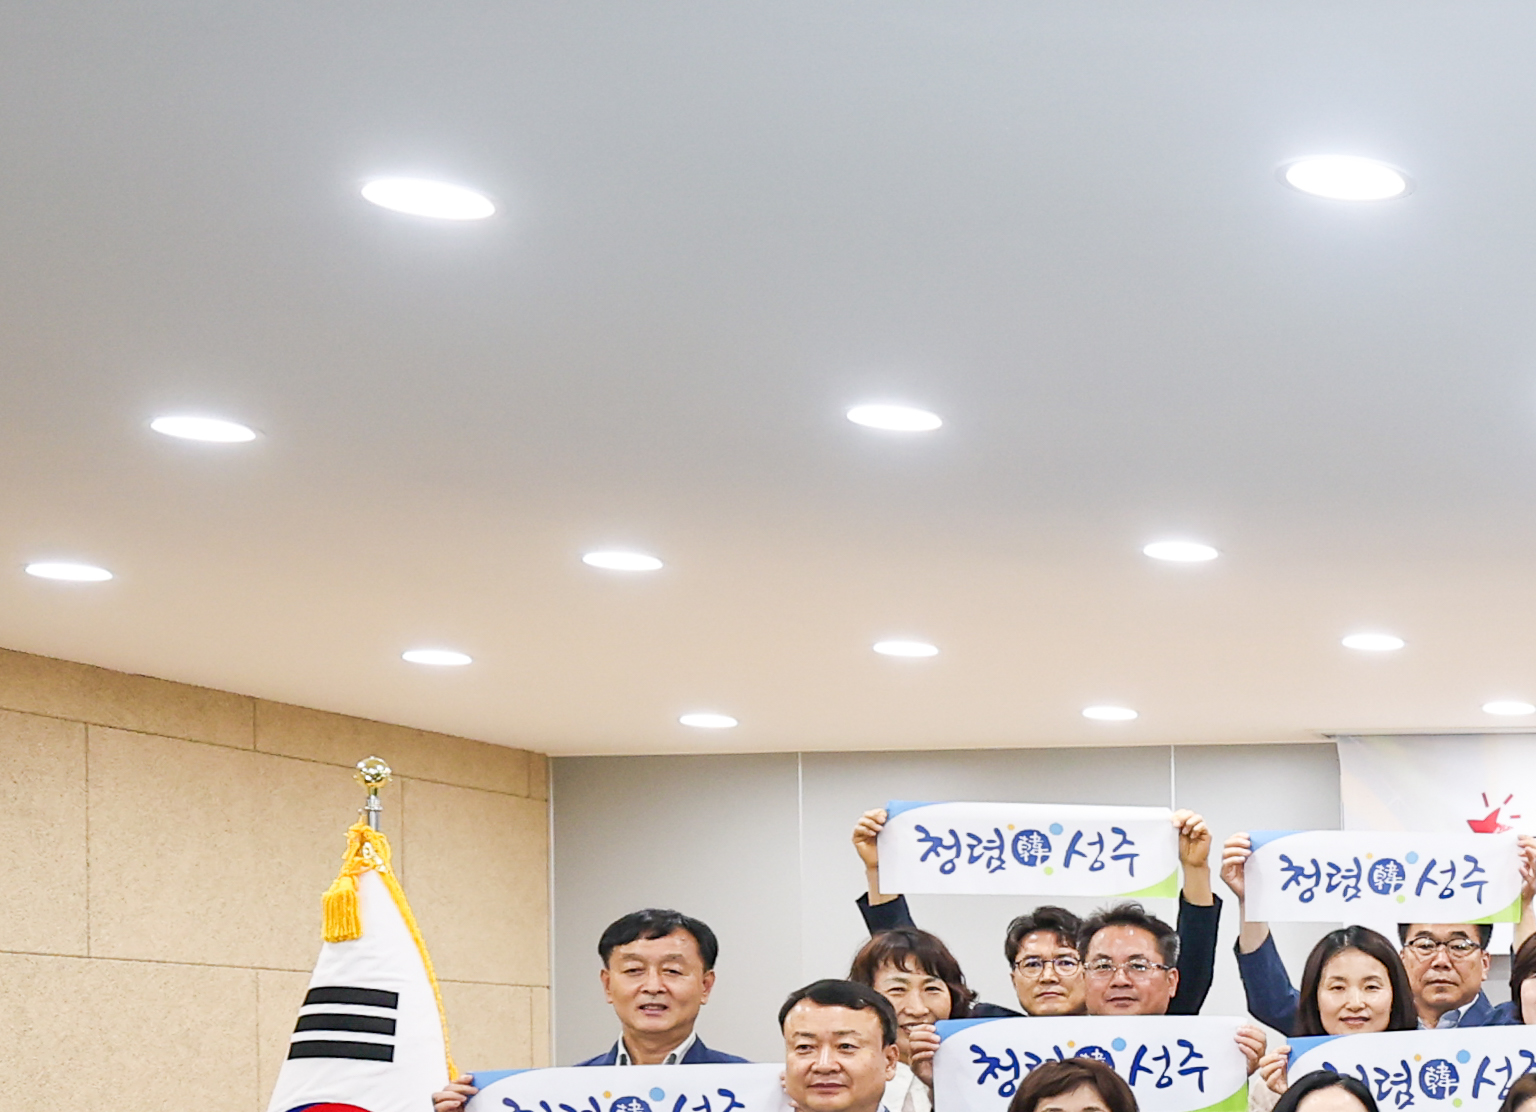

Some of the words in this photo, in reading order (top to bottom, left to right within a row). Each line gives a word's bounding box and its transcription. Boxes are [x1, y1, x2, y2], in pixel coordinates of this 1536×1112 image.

[1063, 826, 1140, 878] 성주
[1415, 854, 1489, 904] 성주
[1129, 1038, 1209, 1094] 성주
